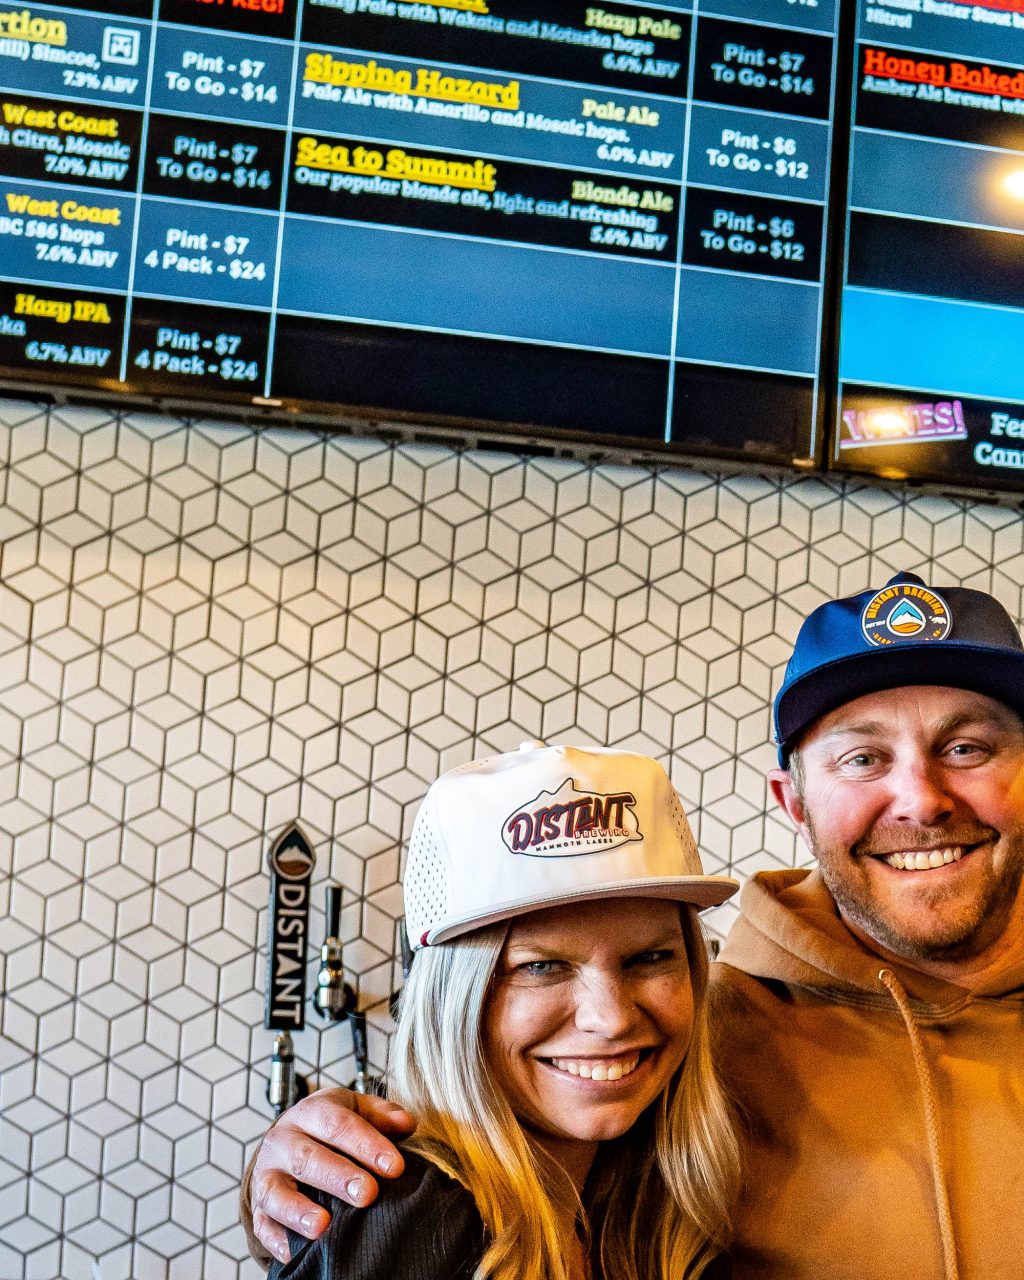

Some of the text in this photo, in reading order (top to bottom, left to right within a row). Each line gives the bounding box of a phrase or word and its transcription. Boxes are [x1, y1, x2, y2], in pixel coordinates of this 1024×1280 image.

[585, 8, 681, 40] Hazy Pale
[183, 50, 266, 79] Pint $7
[724, 42, 805, 73] Pint $7
[864, 49, 945, 83] Honey
[165, 71, 278, 103] To Go $14
[304, 52, 520, 108] Sipping Hazard
[710, 63, 814, 96] To Go $14
[3, 103, 118, 137] West Coast
[302, 81, 340, 103] Pale
[342, 89, 372, 107] Ale
[374, 93, 414, 113] with
[491, 108, 525, 128] and
[582, 99, 659, 127] Pale Ale
[12, 129, 64, 154] Citra,
[175, 136, 258, 164] Pint $7
[721, 128, 796, 156] Pint $6
[157, 157, 272, 189] To Go $14
[298, 137, 497, 190] Sea to Summit
[637, 149, 674, 169] ABV
[706, 148, 808, 179] To Go $12
[6, 194, 121, 226] West Coast
[295, 166, 328, 184] Our
[329, 173, 400, 195] popular
[401, 180, 459, 203] blonde
[493, 191, 534, 214] light
[535, 200, 569, 219] and
[570, 203, 658, 232] refreshing
[572, 180, 674, 212] Blonde Ale
[714, 210, 794, 238] Pint $6
[166, 228, 249, 255] Pint $7
[701, 230, 804, 261] To Go $12
[77, 248, 118, 268] ABV
[144, 250, 266, 281] 4 Pack $24
[15, 293, 111, 324] Hazy IPA
[69, 346, 111, 367] ABV
[157, 328, 241, 355] Pint $7
[135, 350, 258, 382] 4 Pack $24
[507, 795, 635, 850] DISTANT
[575, 829, 629, 838] BREWING
[536, 841, 582, 852] MAMMOTH
[271, 884, 307, 1025] DISTANT
